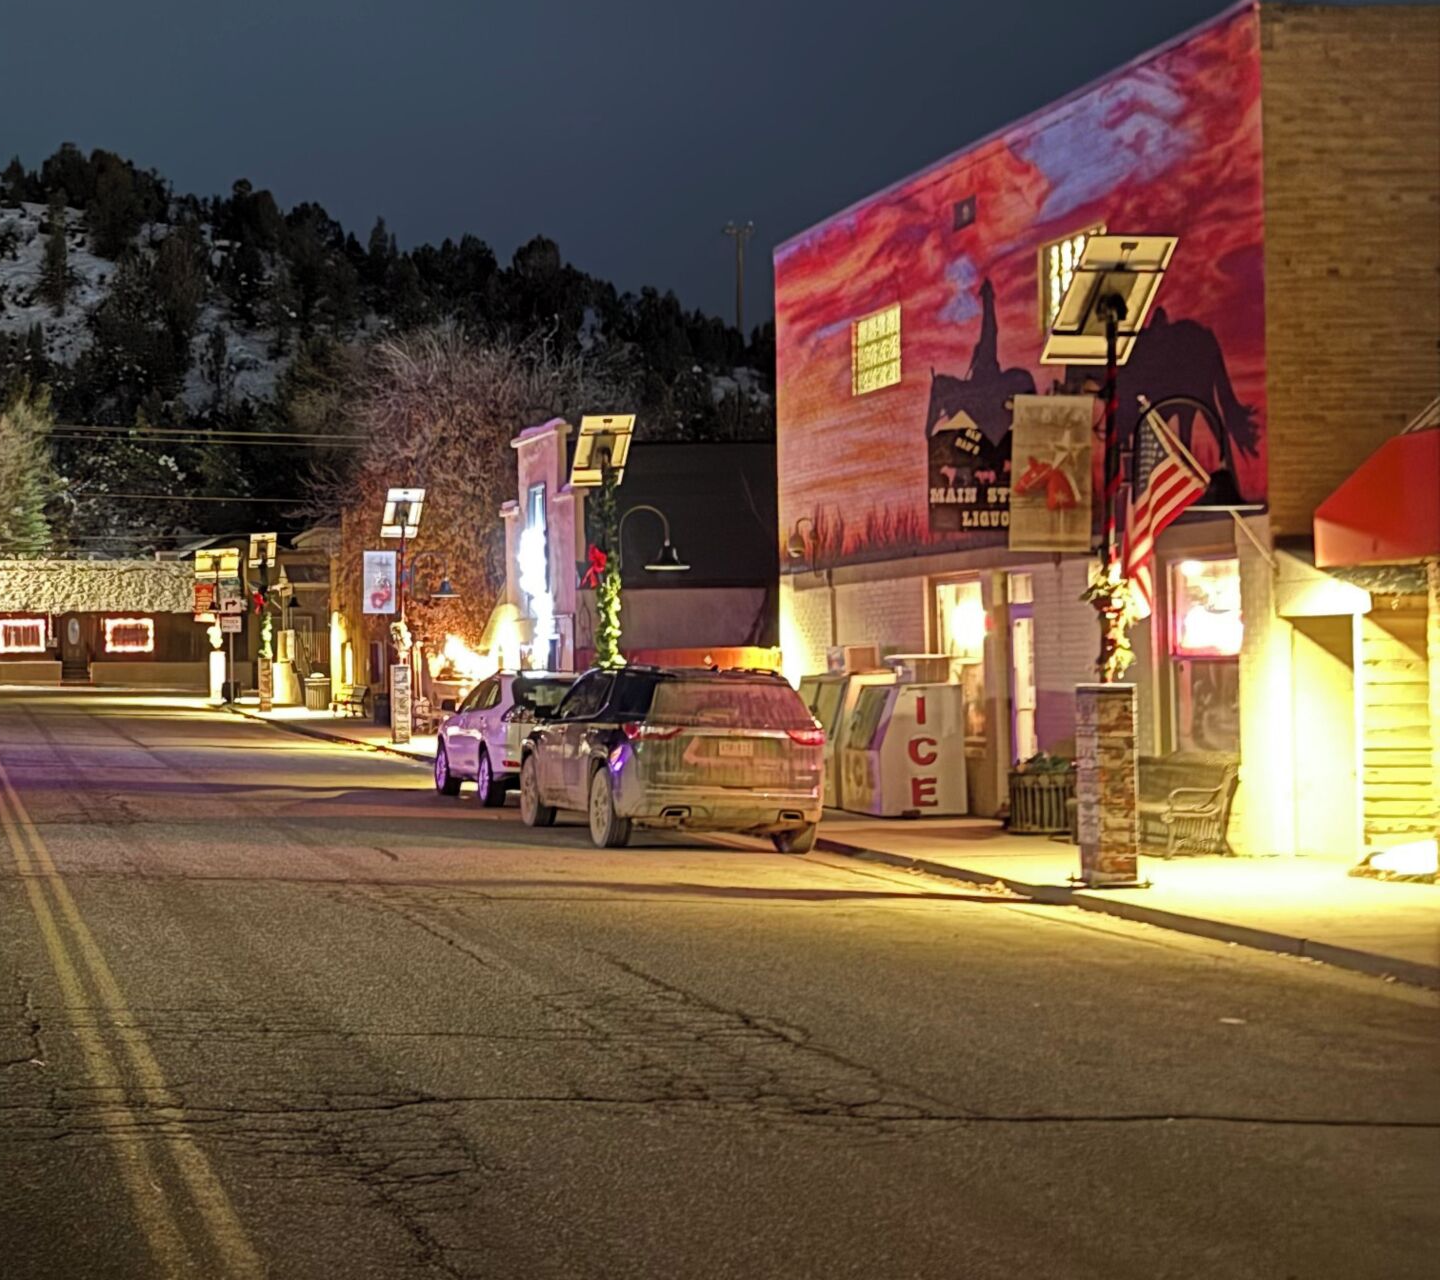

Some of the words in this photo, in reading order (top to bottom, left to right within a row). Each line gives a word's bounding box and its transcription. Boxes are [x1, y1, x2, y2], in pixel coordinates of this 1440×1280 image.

[930, 487, 977, 504] MAIN
[987, 487, 1011, 504] ST
[962, 510, 1010, 527] LIQUO
[907, 696, 939, 807] ICE
